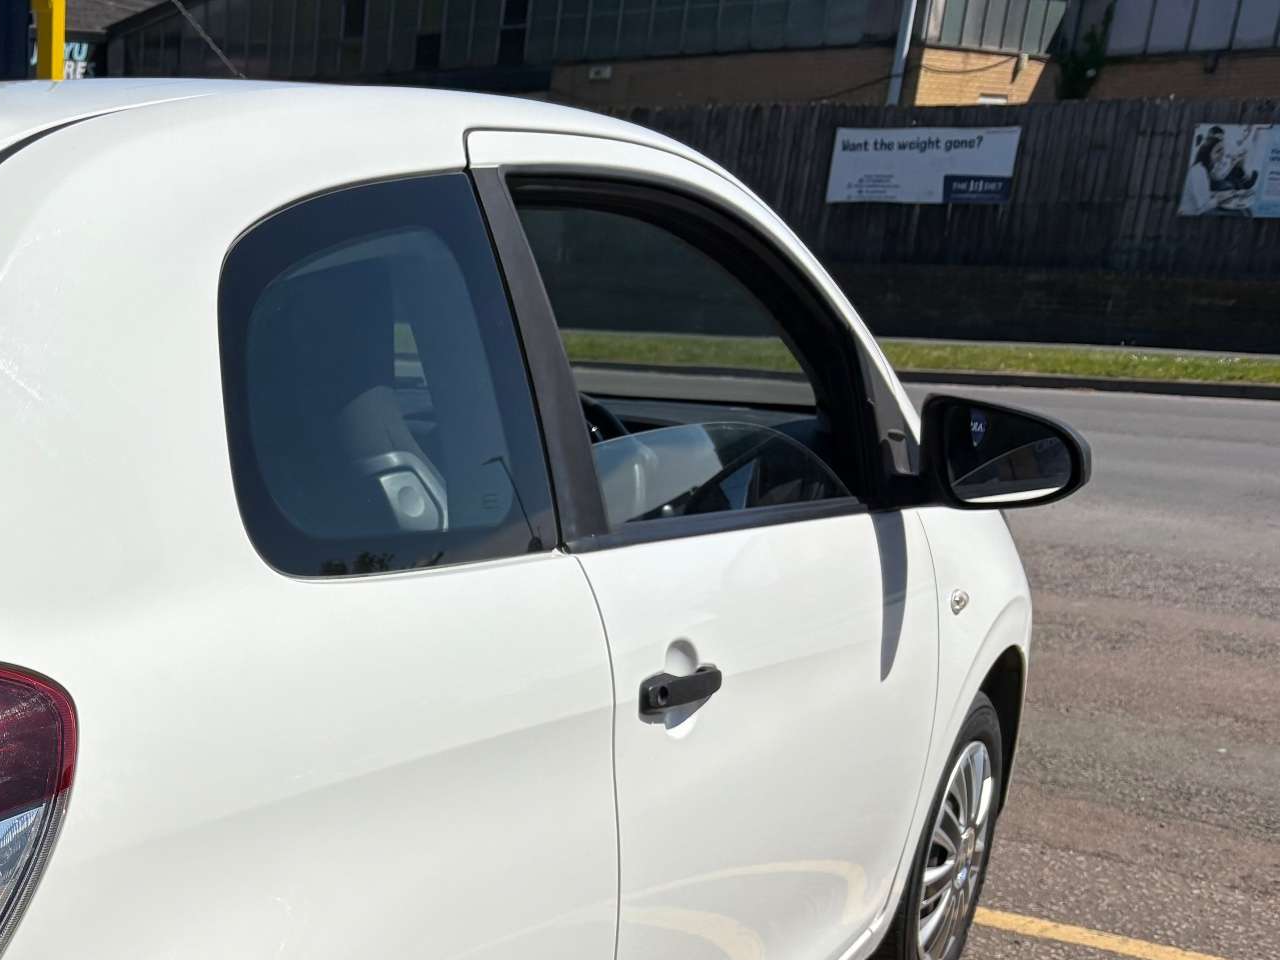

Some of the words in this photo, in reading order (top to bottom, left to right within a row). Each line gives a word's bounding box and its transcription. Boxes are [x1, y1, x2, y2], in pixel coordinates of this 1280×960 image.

[841, 138, 869, 152] Want
[873, 138, 893, 152] the
[898, 137, 941, 153] weight
[945, 135, 984, 153] gone?
